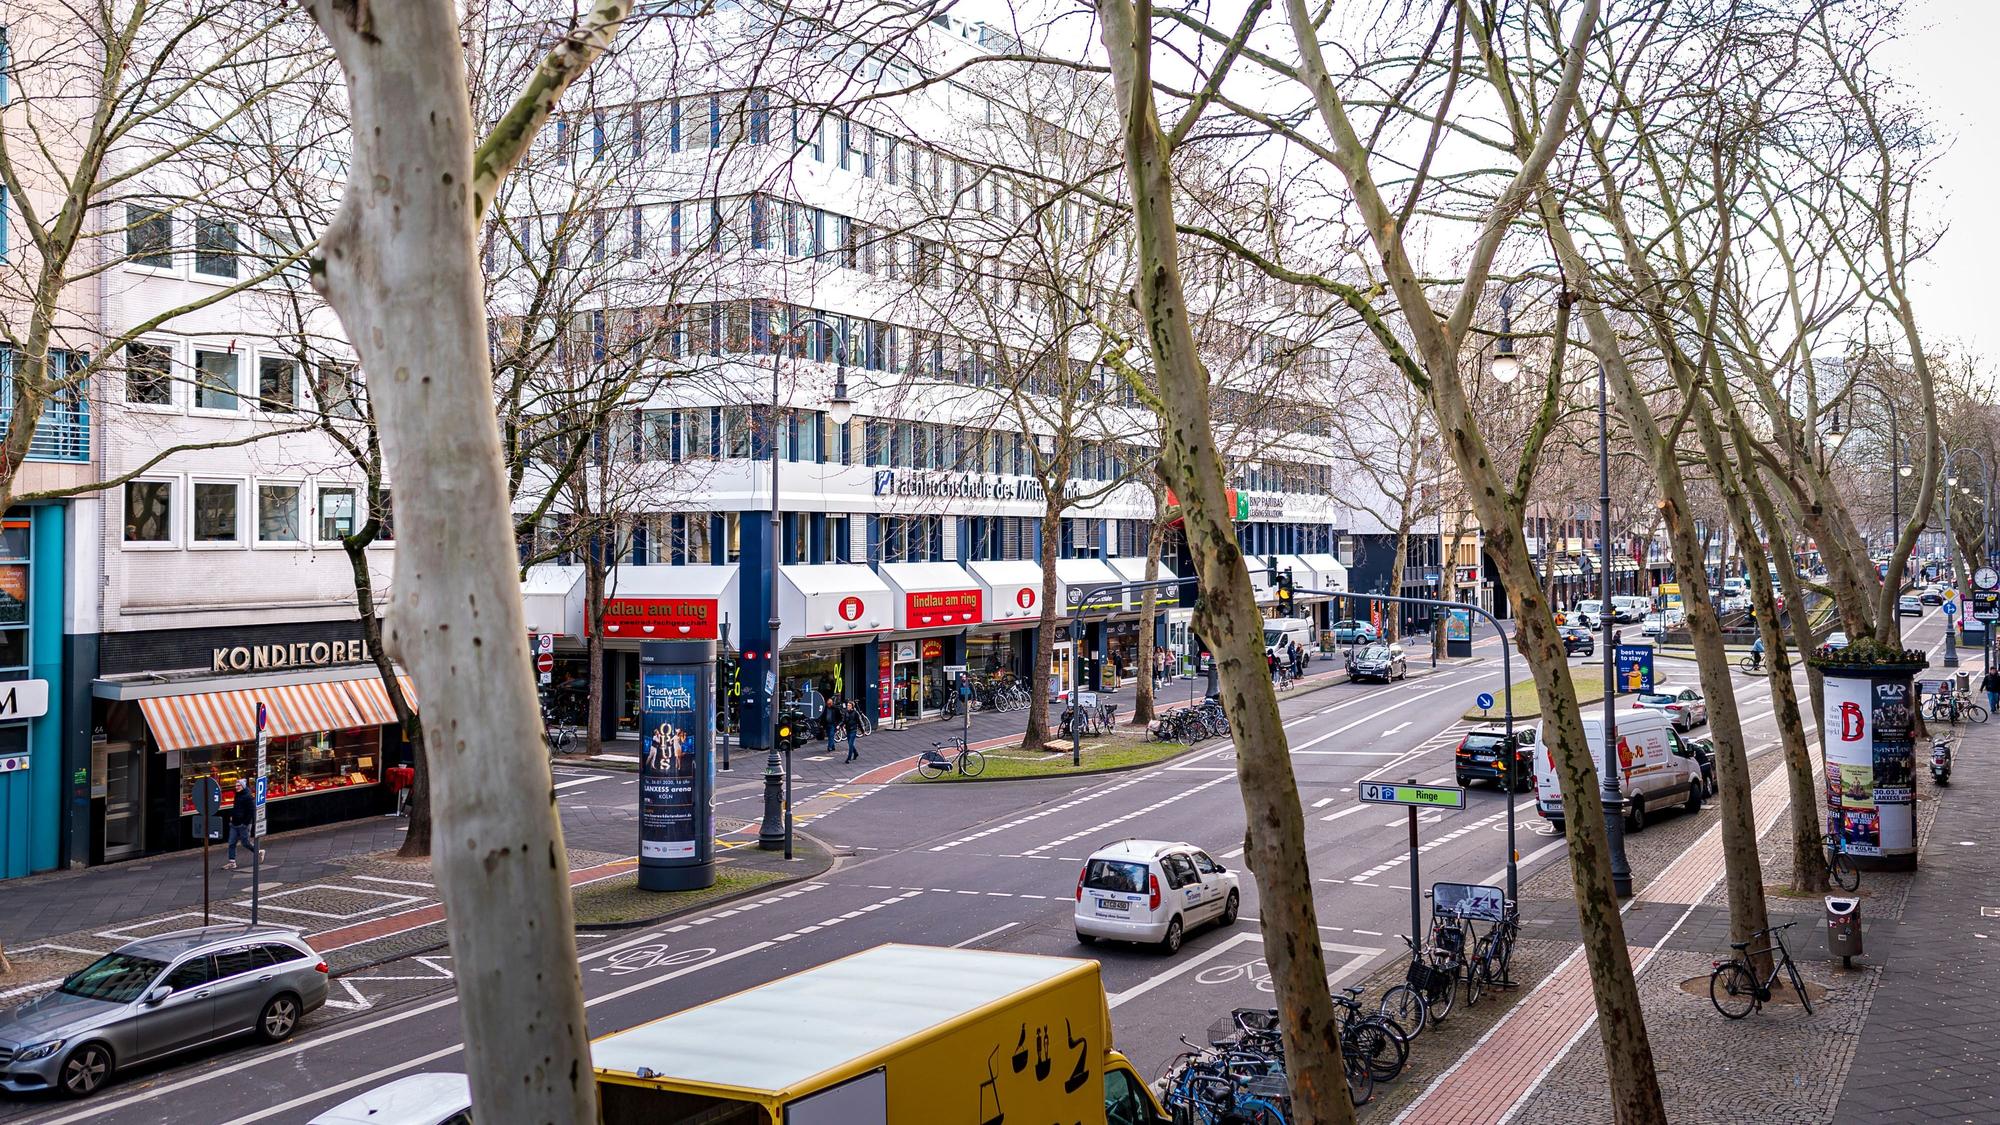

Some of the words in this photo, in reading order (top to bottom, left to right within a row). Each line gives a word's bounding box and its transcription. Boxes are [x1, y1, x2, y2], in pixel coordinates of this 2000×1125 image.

[995, 477, 1014, 499] des
[1249, 496, 1261, 507] BNP
[1261, 496, 1284, 508] PARIBAS
[912, 594, 943, 608] lindlau
[945, 595, 958, 606] am
[960, 592, 977, 607] ring
[647, 605, 672, 616] am
[677, 602, 708, 619] ring
[647, 684, 688, 697] Feuerwerk
[1876, 683, 1907, 697] PUR
[646, 692, 691, 709] Turnkunst
[644, 785, 670, 793] LANXESS
[1415, 790, 1438, 801] Ringe
